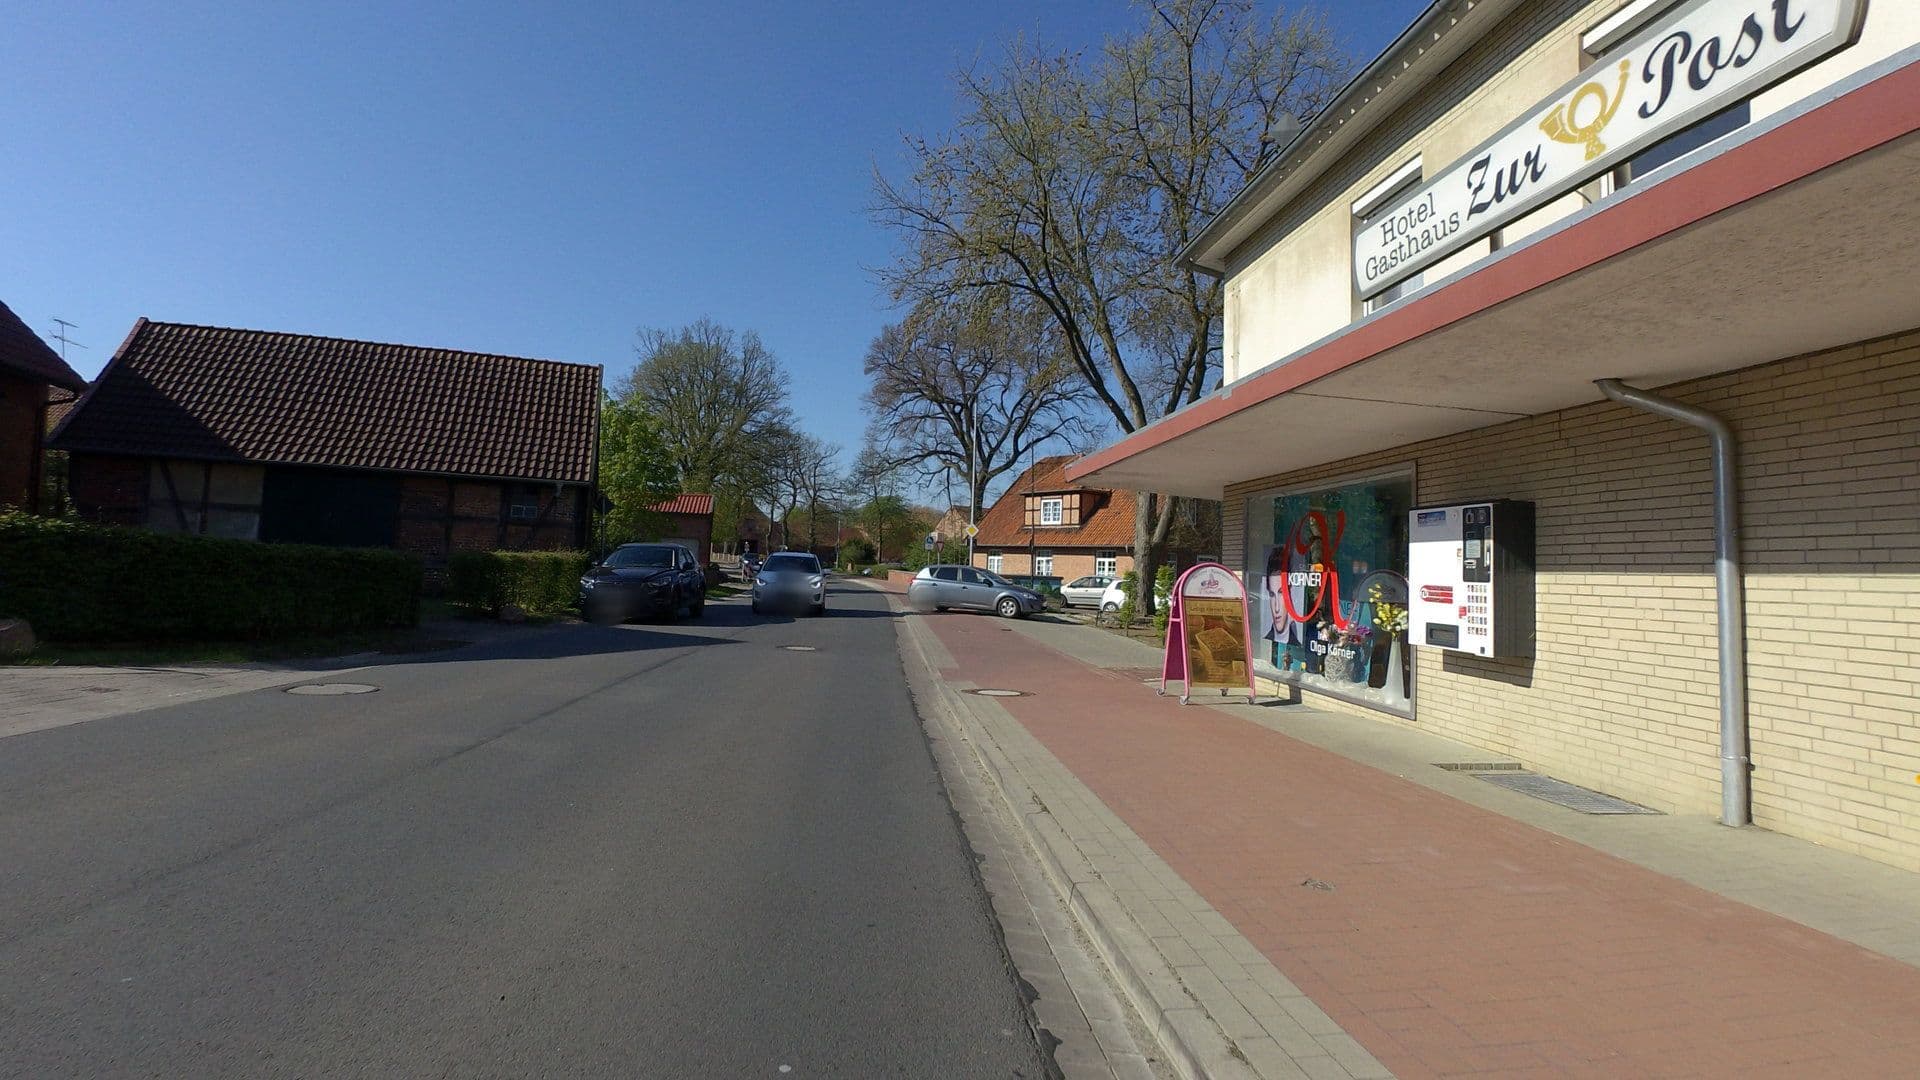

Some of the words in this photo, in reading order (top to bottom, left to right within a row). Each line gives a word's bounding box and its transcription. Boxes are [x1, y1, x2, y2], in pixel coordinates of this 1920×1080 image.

[1466, 143, 1547, 221] Zur
[1637, 0, 1806, 119] Post
[1365, 211, 1460, 281] Gasthaus
[1380, 192, 1436, 247] Hotel
[1310, 640, 1326, 656] Olga
